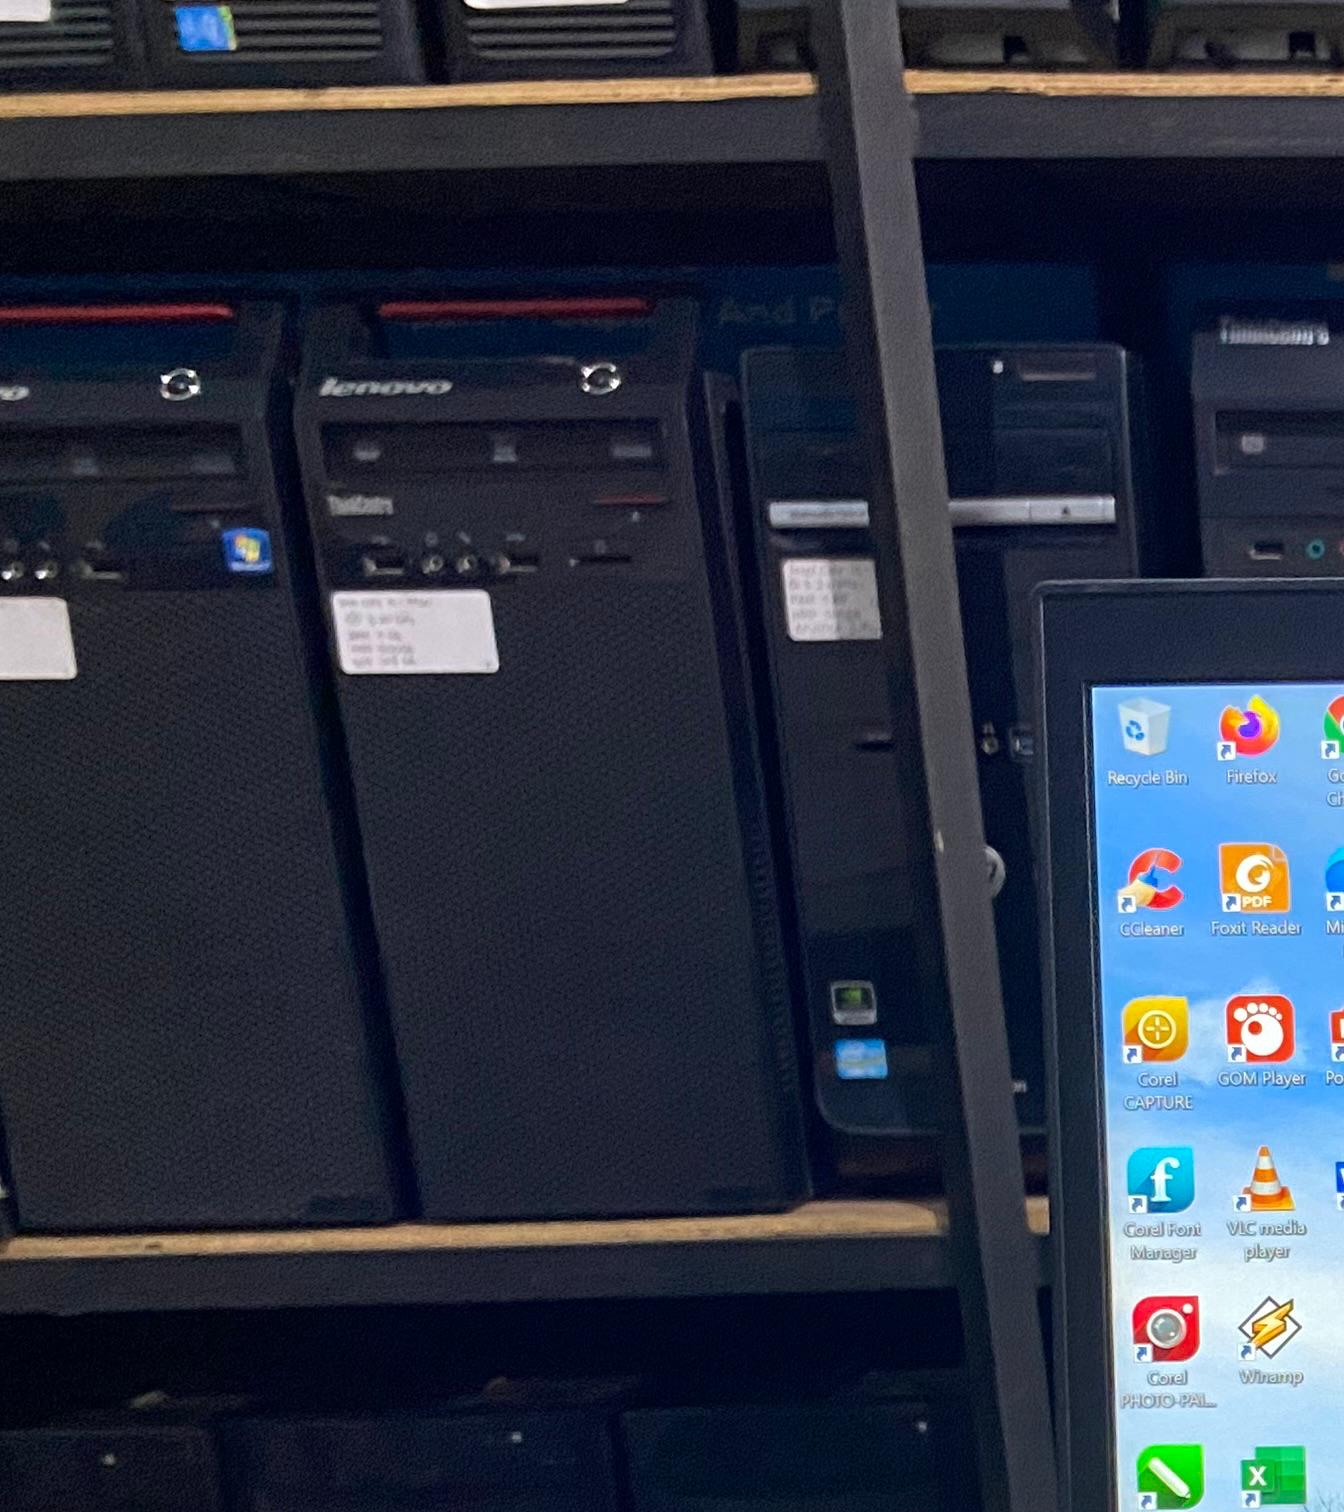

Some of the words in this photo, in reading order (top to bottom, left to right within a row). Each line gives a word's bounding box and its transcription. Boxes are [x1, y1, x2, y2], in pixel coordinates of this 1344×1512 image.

[319, 376, 453, 398] lenovo
[1108, 771, 1161, 788] Recycle
[1165, 770, 1188, 785] Bin
[1226, 769, 1278, 784] Firefox
[1242, 896, 1272, 908] PDF
[1120, 922, 1184, 937] CCleaner
[1211, 921, 1247, 936] Foxit
[1252, 921, 1302, 936] Reader
[1137, 1072, 1178, 1088] Corel
[1217, 1072, 1258, 1087] GOM
[1263, 1071, 1307, 1089] Player
[1123, 1096, 1192, 1111] CAPTURE
[1123, 1222, 1164, 1238] Corel
[1168, 1221, 1201, 1238] Font
[1226, 1221, 1256, 1237] VLC
[1261, 1220, 1308, 1236] media
[1130, 1246, 1197, 1264] Manager
[1243, 1243, 1290, 1263] player
[1147, 1369, 1189, 1386] Corel
[1239, 1370, 1304, 1386] Winamp
